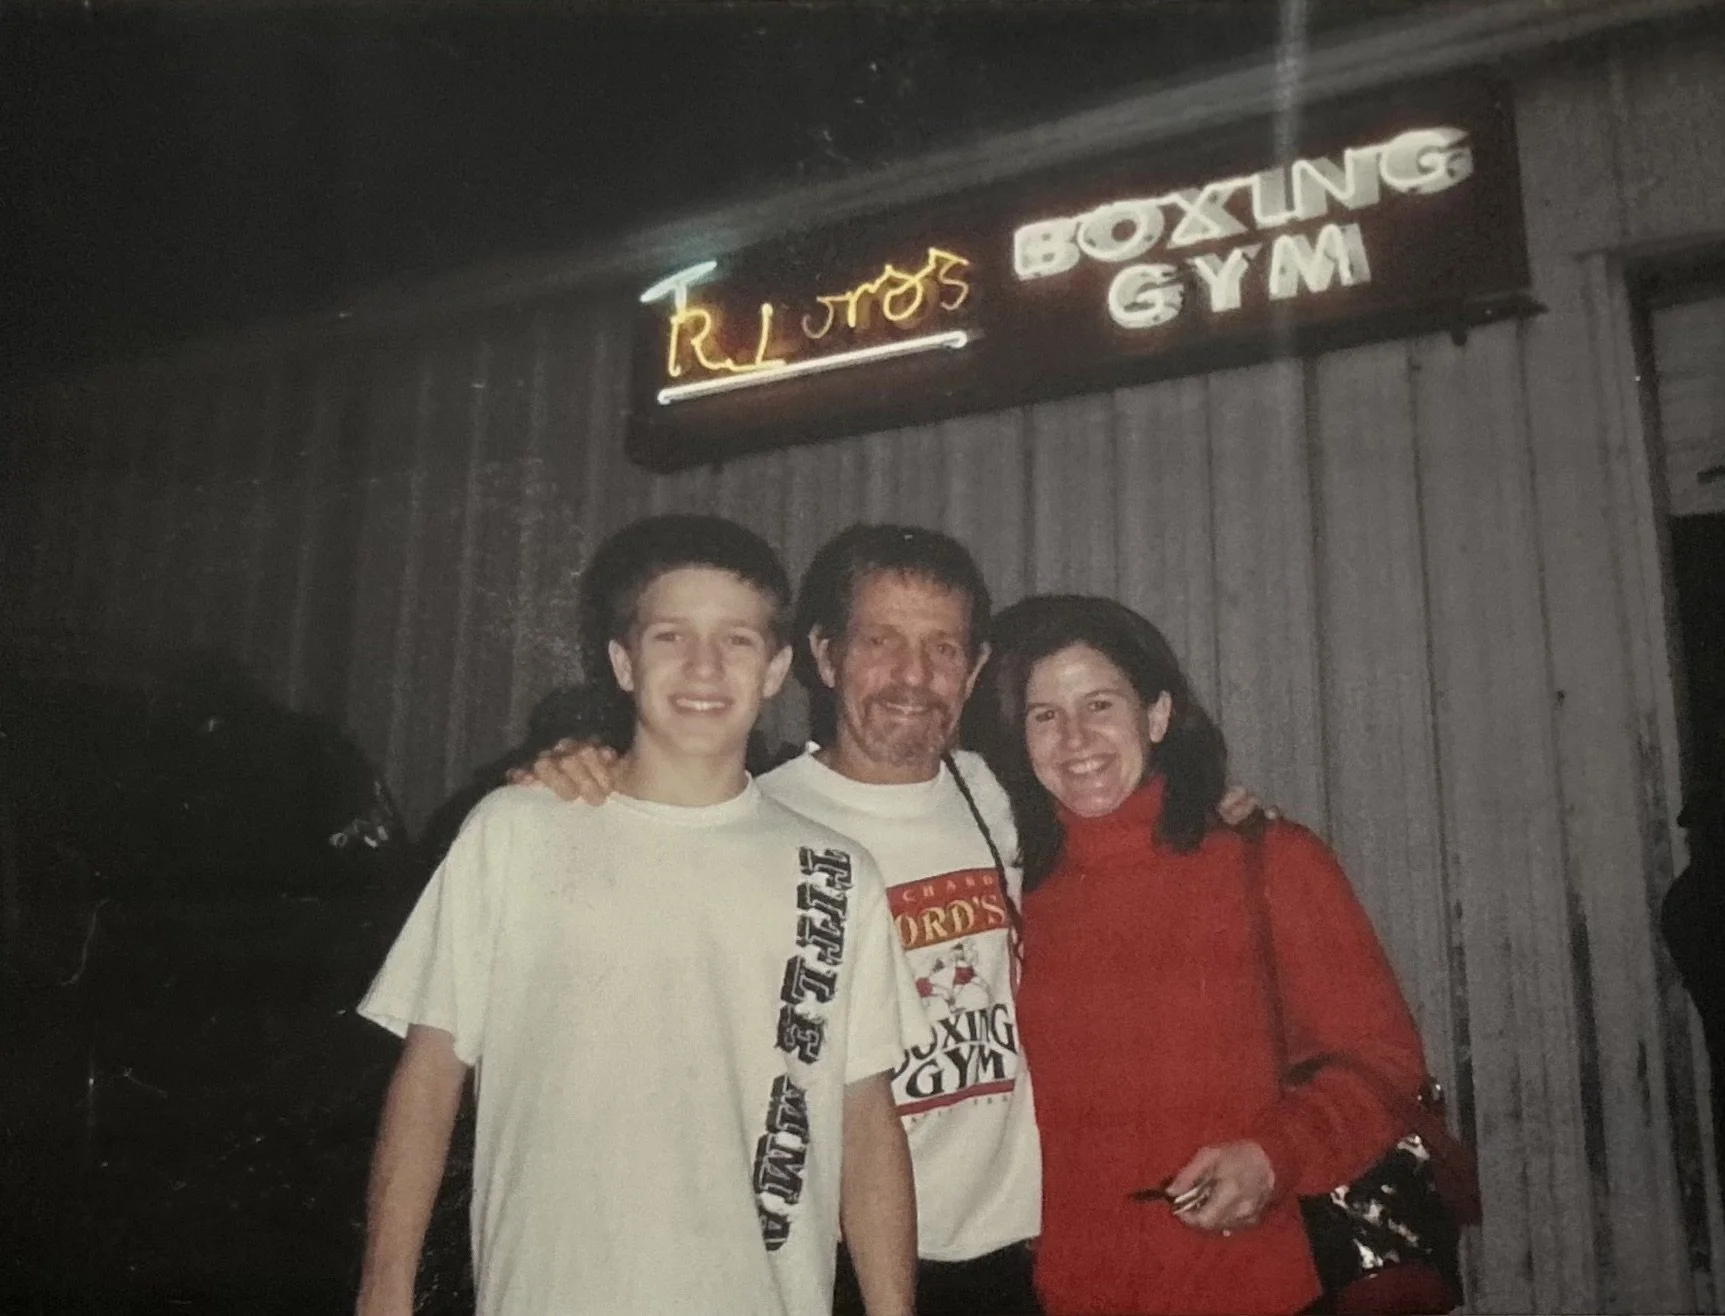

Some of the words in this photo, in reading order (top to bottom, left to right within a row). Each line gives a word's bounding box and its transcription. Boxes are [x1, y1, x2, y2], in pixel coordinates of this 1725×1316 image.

[1013, 126, 1474, 282] BOXING
[1108, 222, 1372, 329] GYM
[776, 845, 854, 1065] TITLE
[889, 1003, 1018, 1081] OXING
[905, 1044, 1006, 1098] GYM
